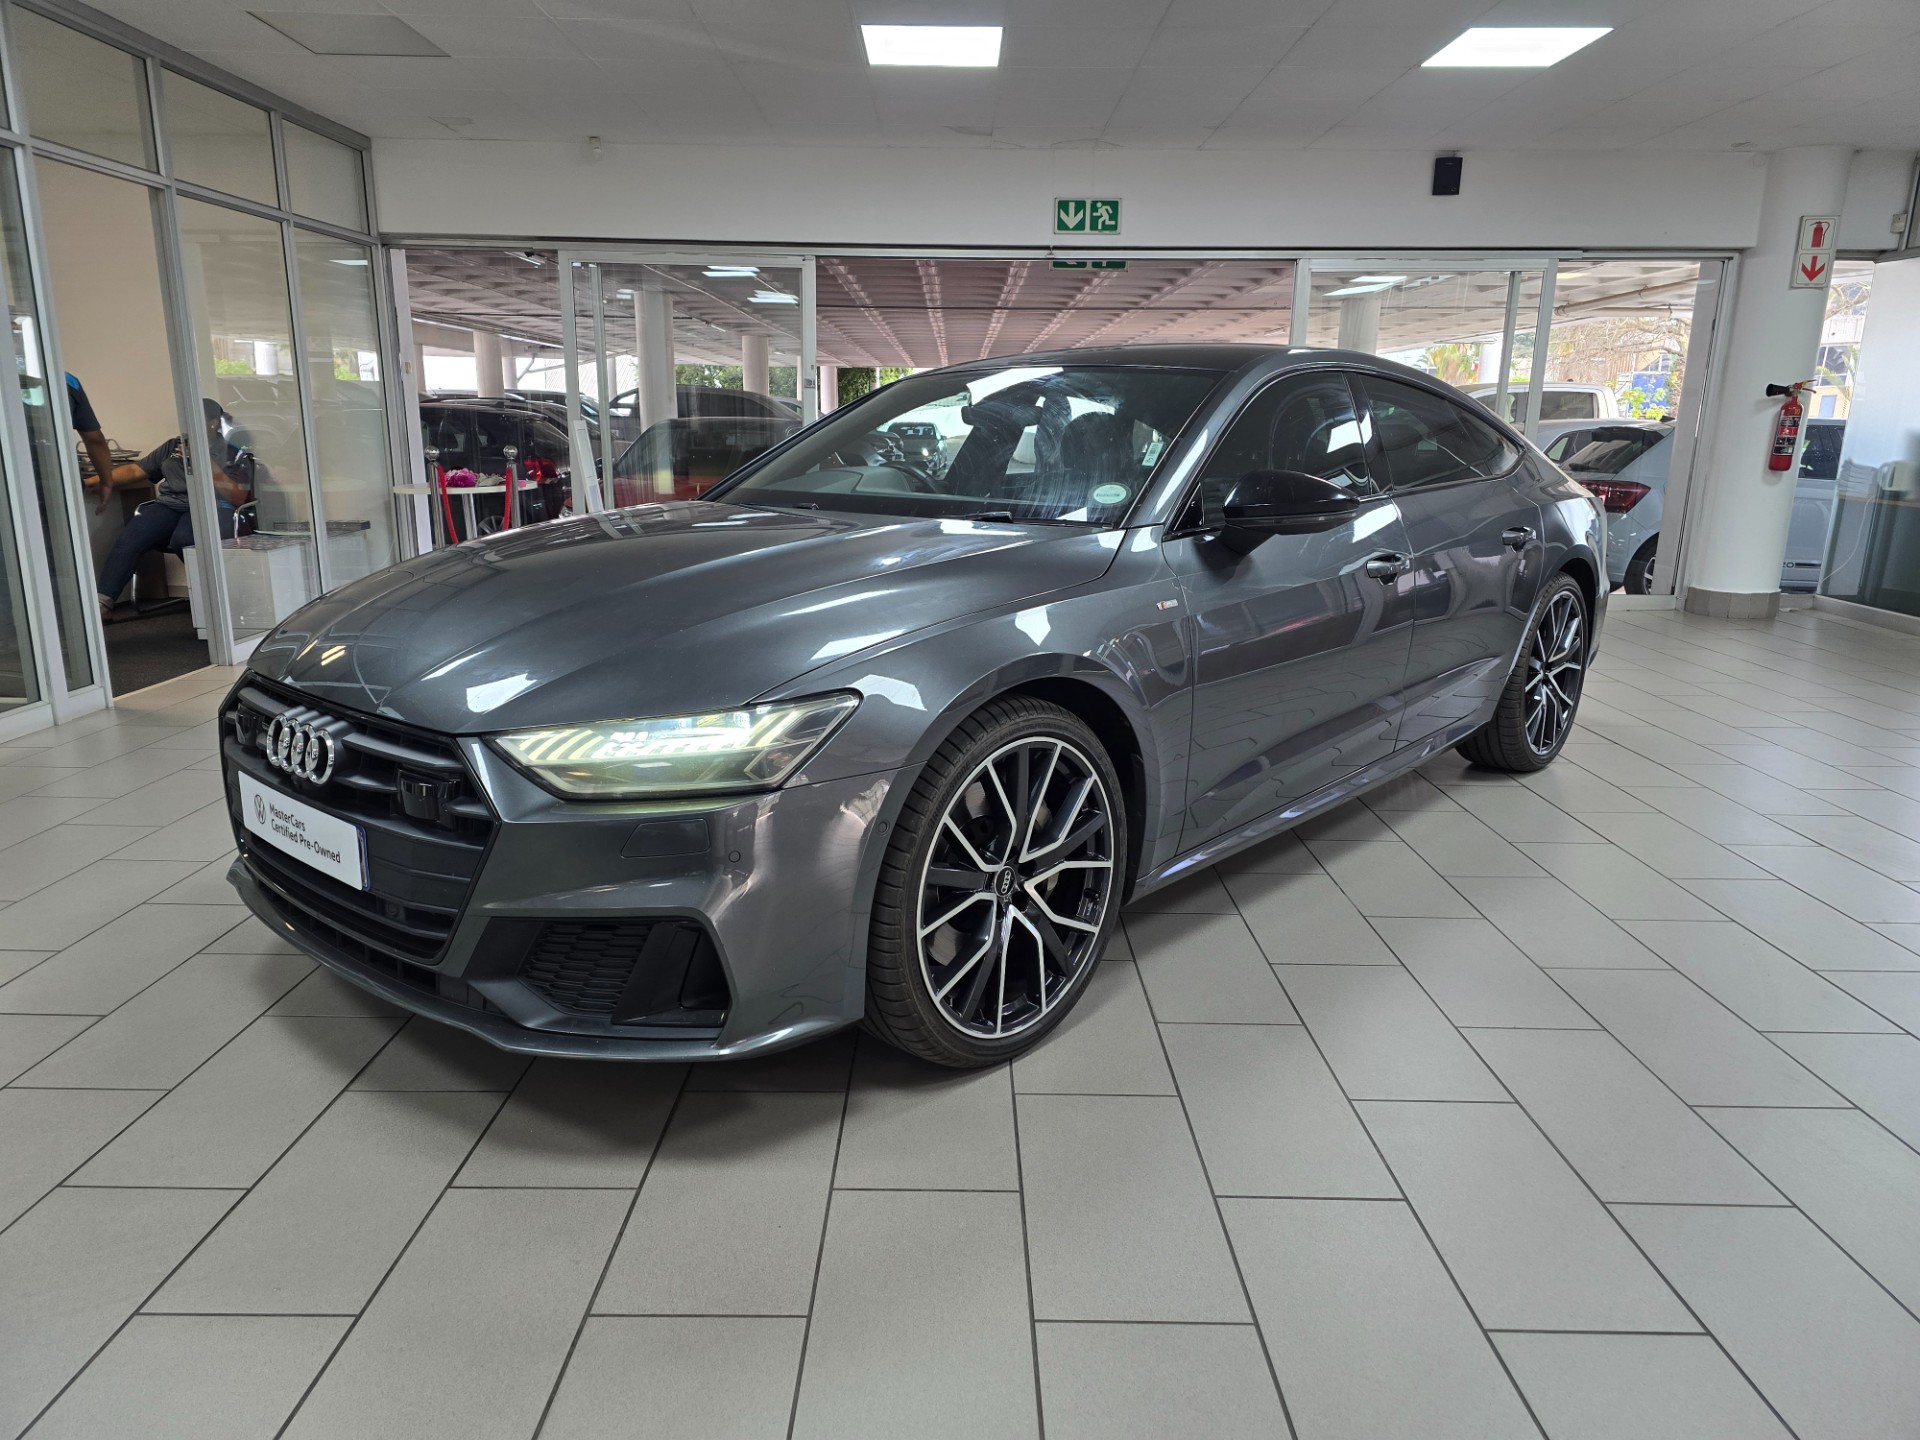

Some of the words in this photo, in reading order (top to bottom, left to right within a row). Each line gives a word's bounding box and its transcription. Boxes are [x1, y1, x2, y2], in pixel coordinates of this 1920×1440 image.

[269, 803, 305, 831] MasterCars
[271, 819, 298, 843] Certified
[300, 834, 340, 863] Pre-Owned
